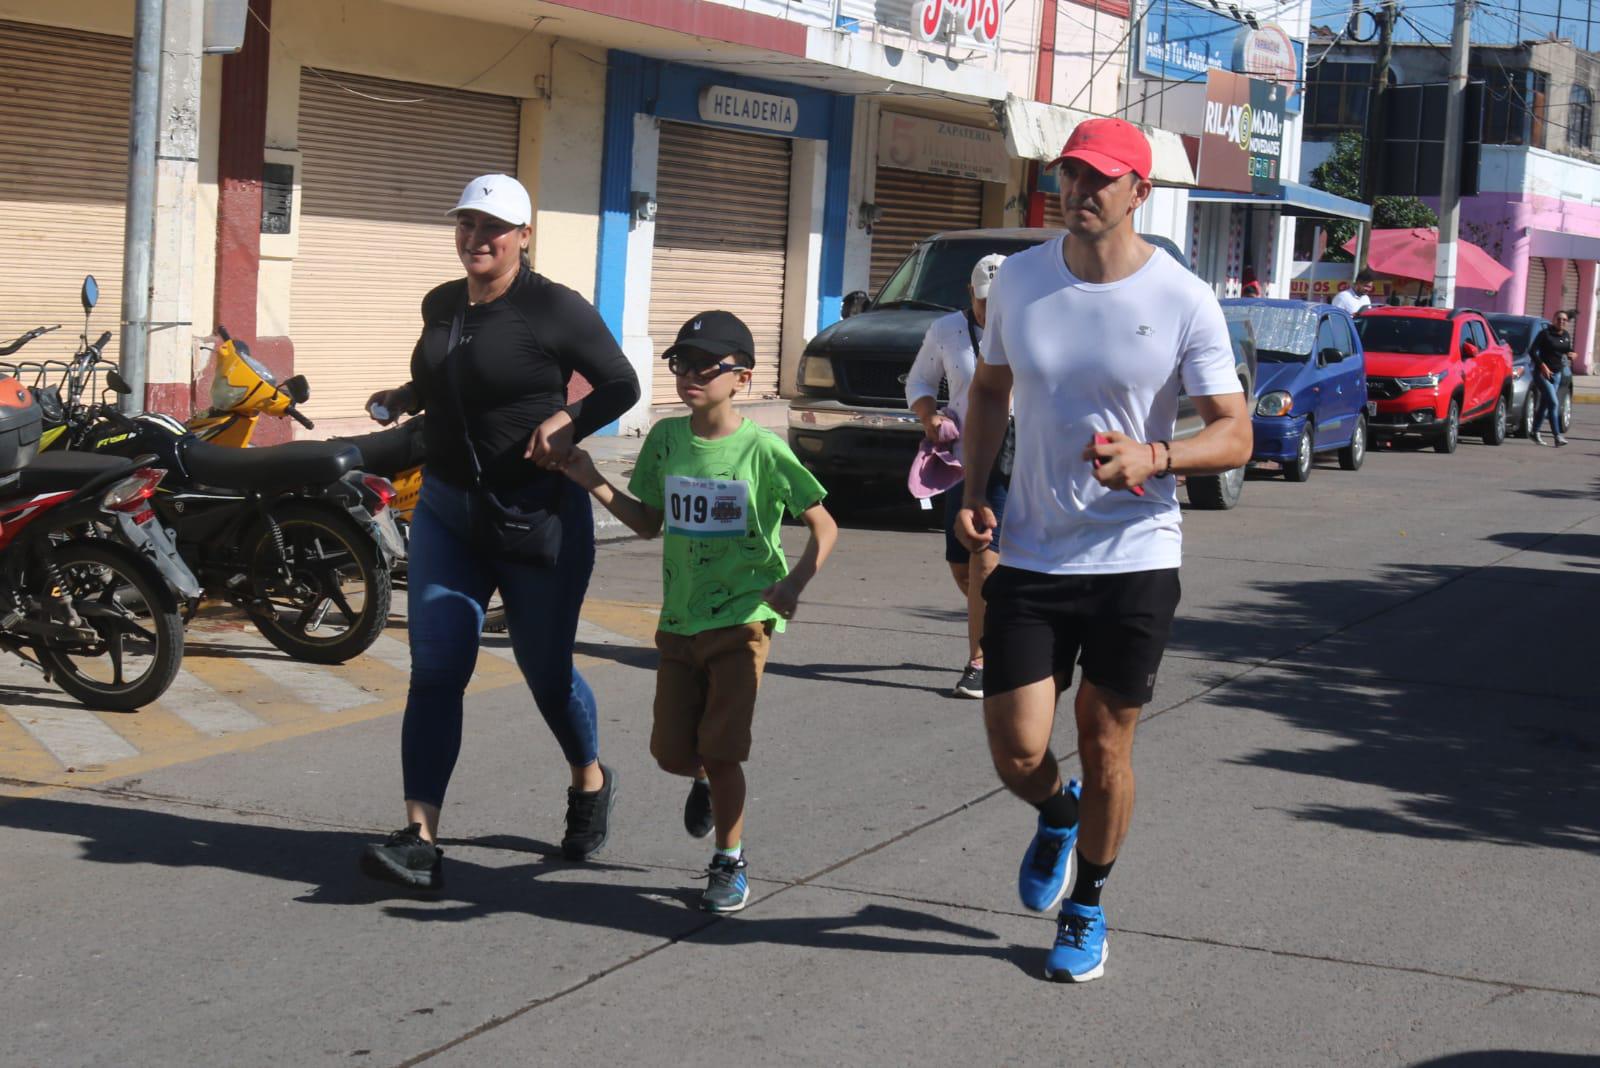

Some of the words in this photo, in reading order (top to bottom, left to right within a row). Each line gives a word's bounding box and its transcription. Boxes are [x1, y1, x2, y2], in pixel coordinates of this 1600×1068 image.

[713, 94, 792, 124] HELADERÍA
[1251, 109, 1279, 137] MODA
[890, 117, 918, 166] 5
[671, 493, 708, 523] 019
